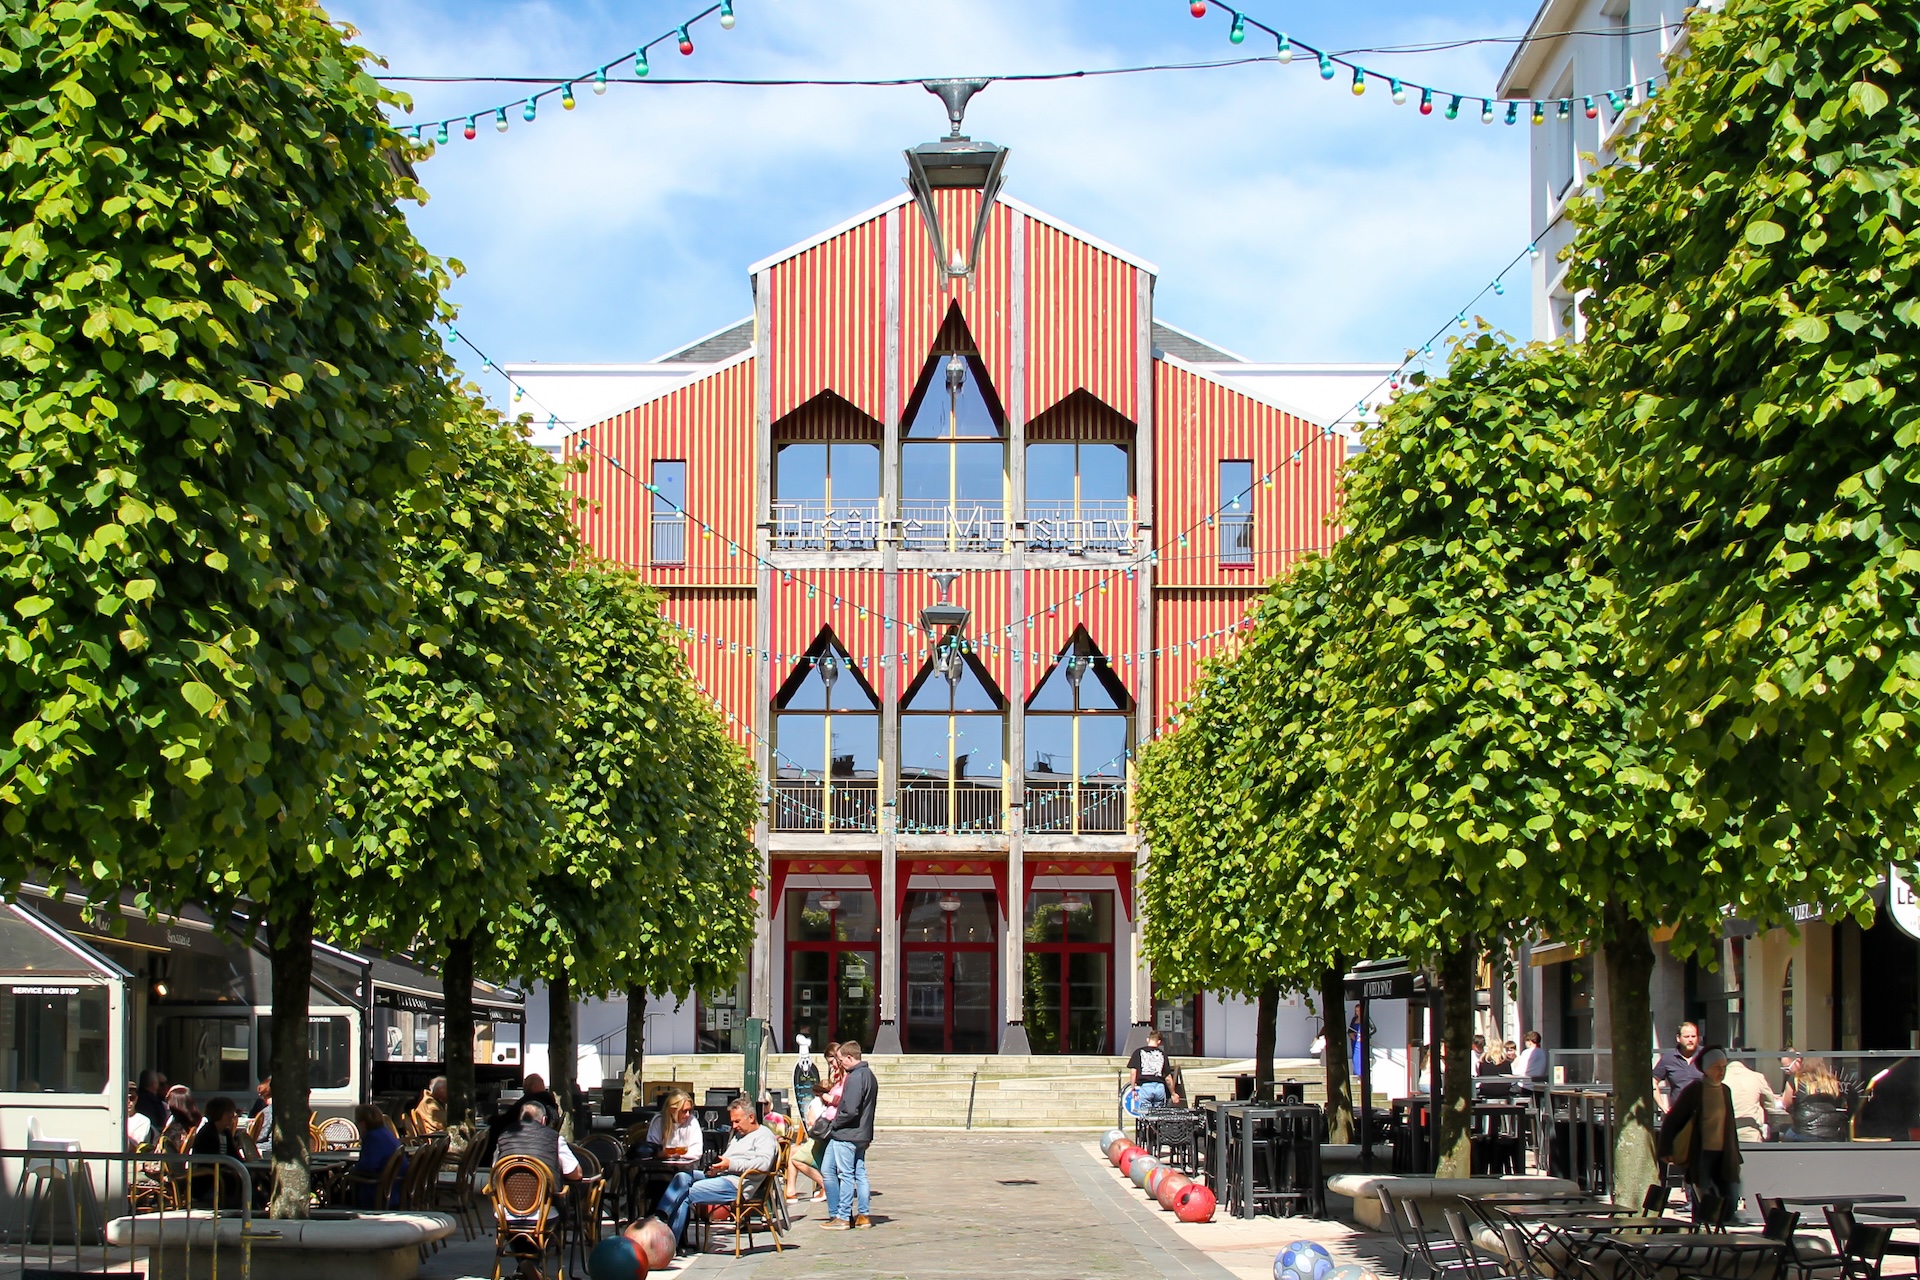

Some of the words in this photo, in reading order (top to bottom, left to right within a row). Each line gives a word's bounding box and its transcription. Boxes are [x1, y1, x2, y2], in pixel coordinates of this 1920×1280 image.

[770, 503, 923, 542] Théâtre
[943, 504, 1137, 552] Monsigny
[12, 987, 42, 995] SERVICE
[43, 987, 59, 995] NON
[60, 987, 80, 995] STOP
